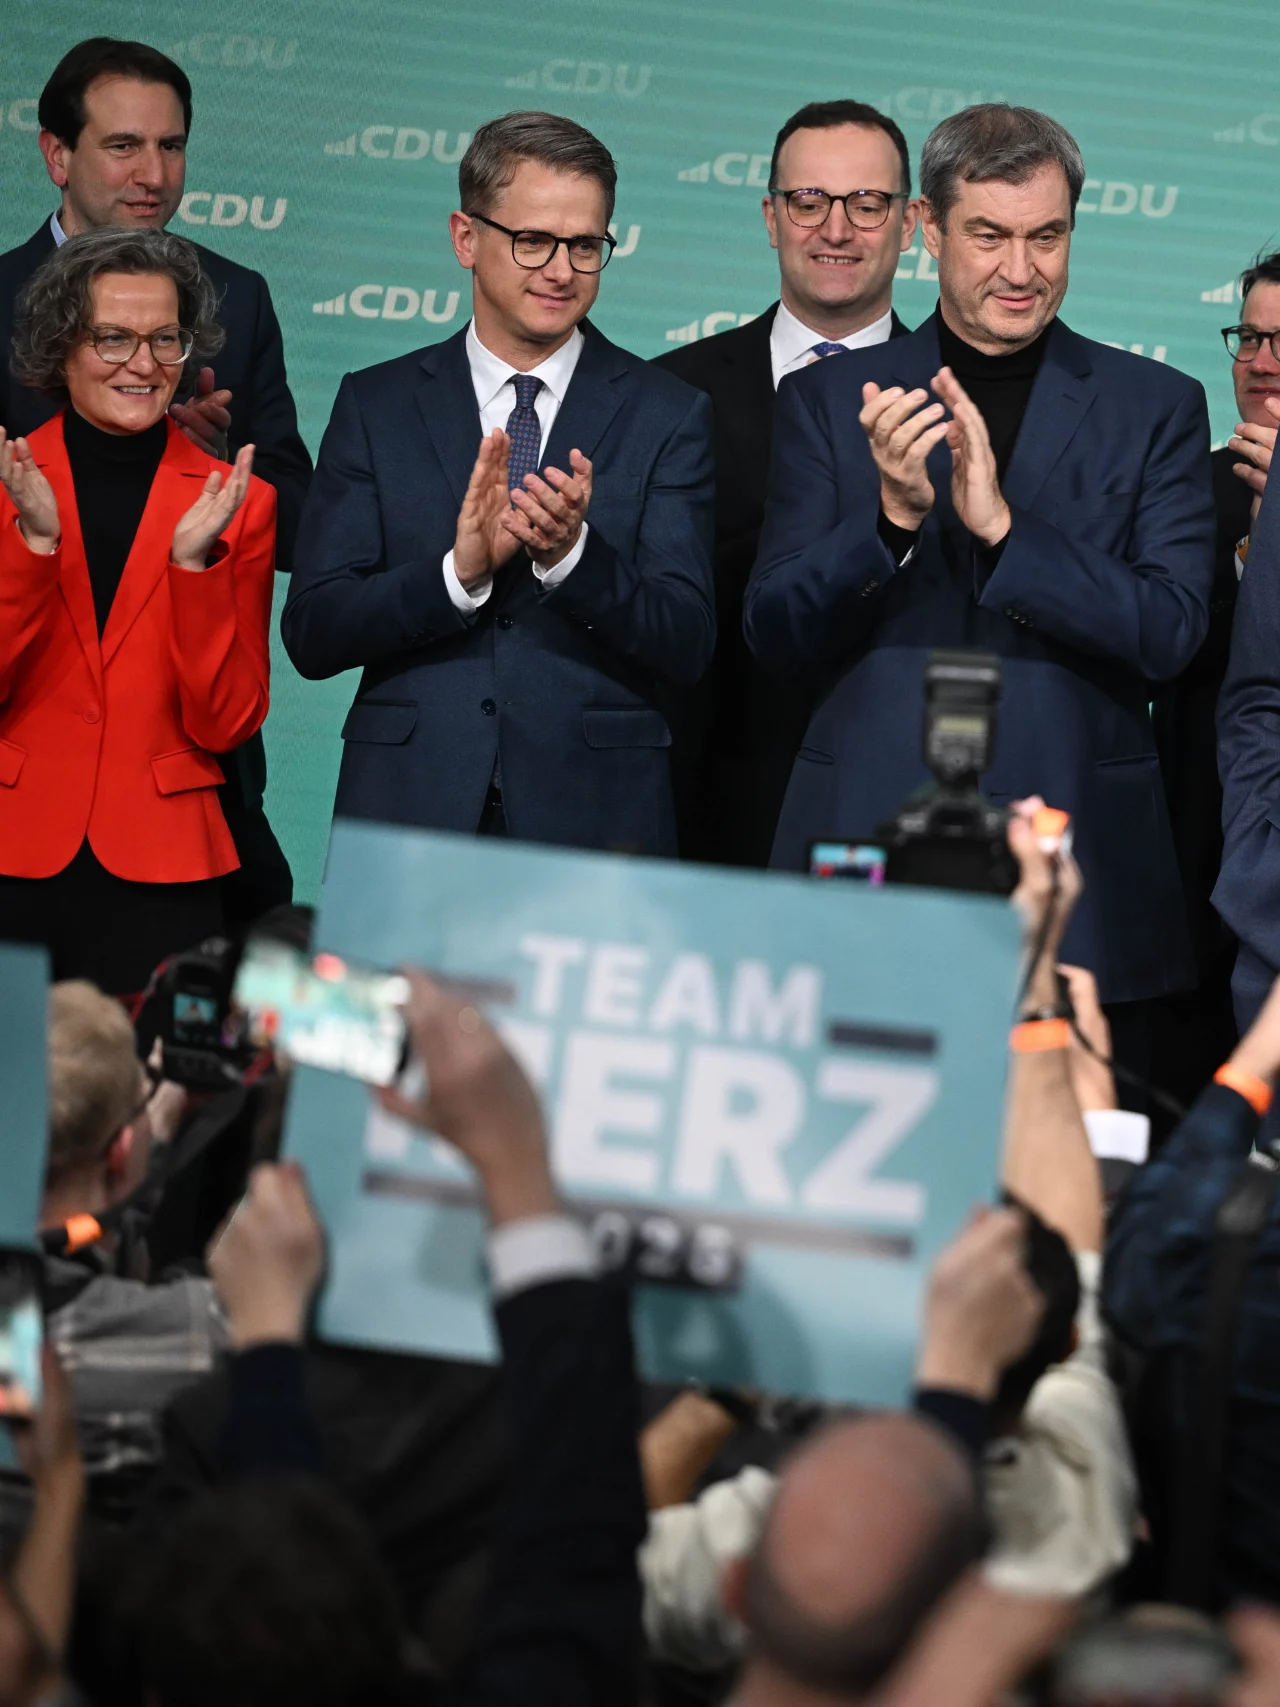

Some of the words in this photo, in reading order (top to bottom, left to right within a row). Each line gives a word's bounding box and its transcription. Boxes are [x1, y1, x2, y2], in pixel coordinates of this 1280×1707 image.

[191, 33, 299, 69] CDU
[541, 59, 651, 96] CDU
[360, 126, 470, 164] CDU
[713, 152, 772, 188] CD
[178, 191, 288, 230] CDU
[1077, 179, 1179, 218] CDU
[349, 284, 460, 324] CDU
[519, 932, 825, 1047] TEAM
